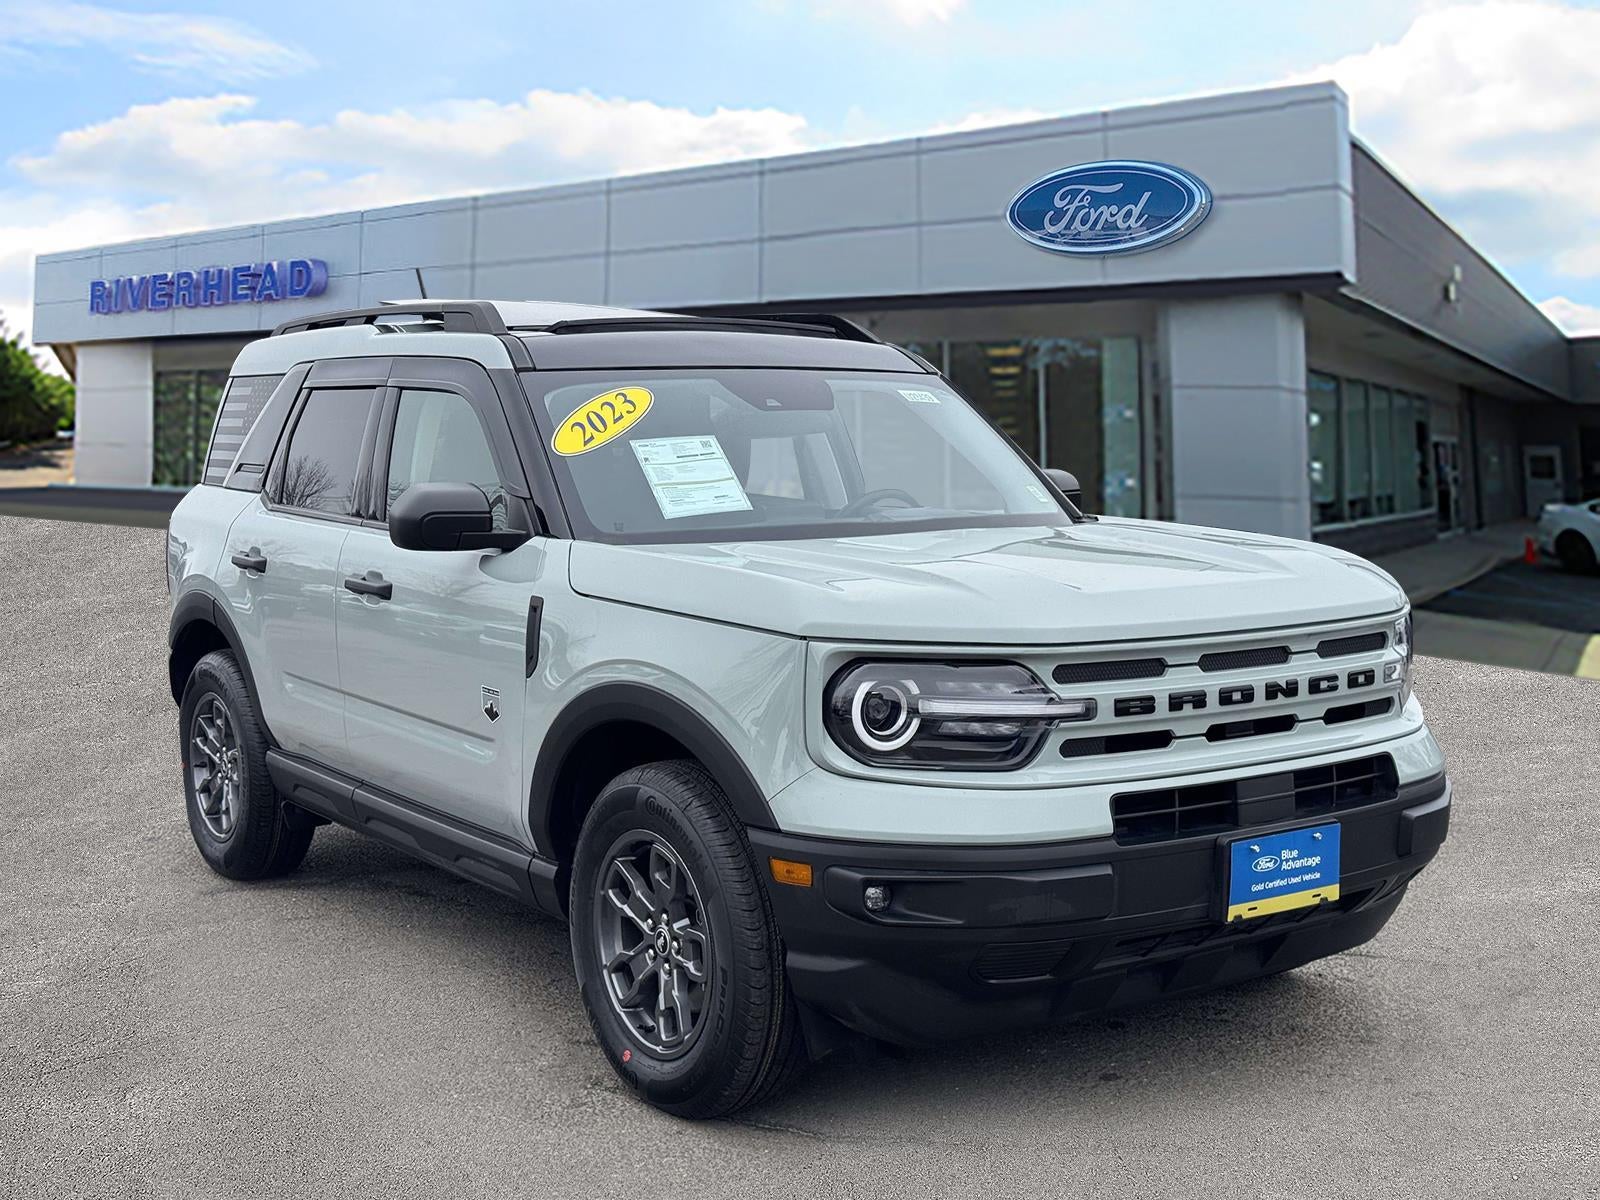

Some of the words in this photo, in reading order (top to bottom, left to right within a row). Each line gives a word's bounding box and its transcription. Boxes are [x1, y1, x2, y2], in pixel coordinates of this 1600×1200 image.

[1044, 183, 1152, 233] Ford
[89, 258, 322, 315] RIVERHEAD
[570, 392, 637, 447] 2023
[1114, 669, 1376, 717] BRONCO
[1281, 849, 1299, 860] Blue
[1281, 856, 1321, 871] Advantage
[1251, 883, 1265, 892] Gold
[1265, 879, 1288, 889] Certified
[1287, 875, 1302, 884] Used
[1302, 872, 1321, 881] Vehicle
